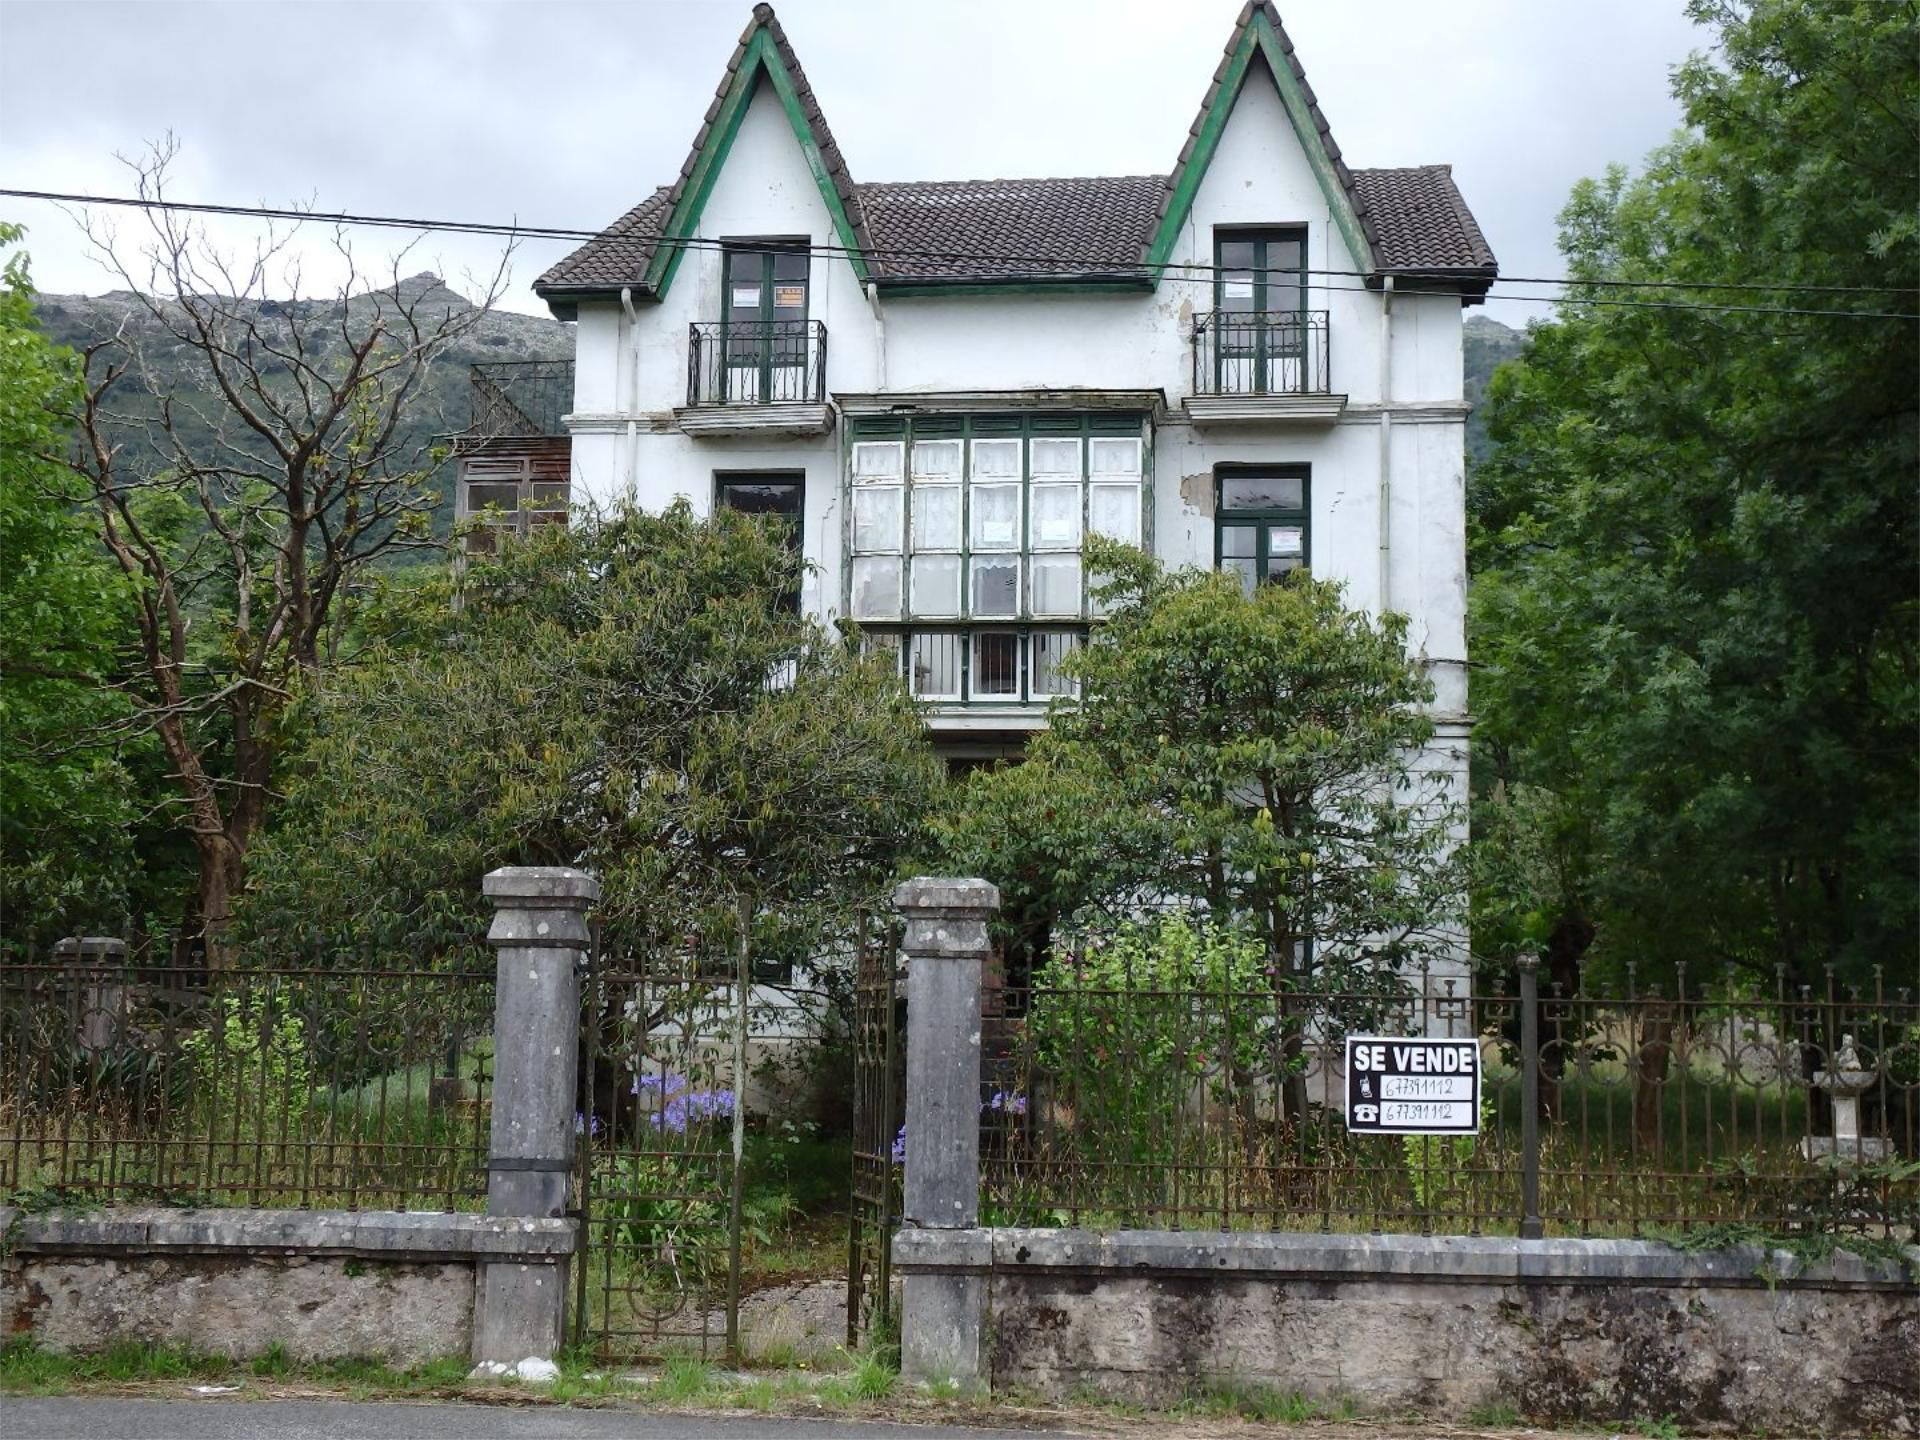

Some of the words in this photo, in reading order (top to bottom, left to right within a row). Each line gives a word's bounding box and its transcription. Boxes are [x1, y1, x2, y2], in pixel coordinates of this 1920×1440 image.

[1354, 1045, 1386, 1072] SE
[1392, 1046, 1473, 1073] VENDE
[1386, 1078, 1453, 1097] 677391112
[1386, 1103, 1453, 1121] 677391112
